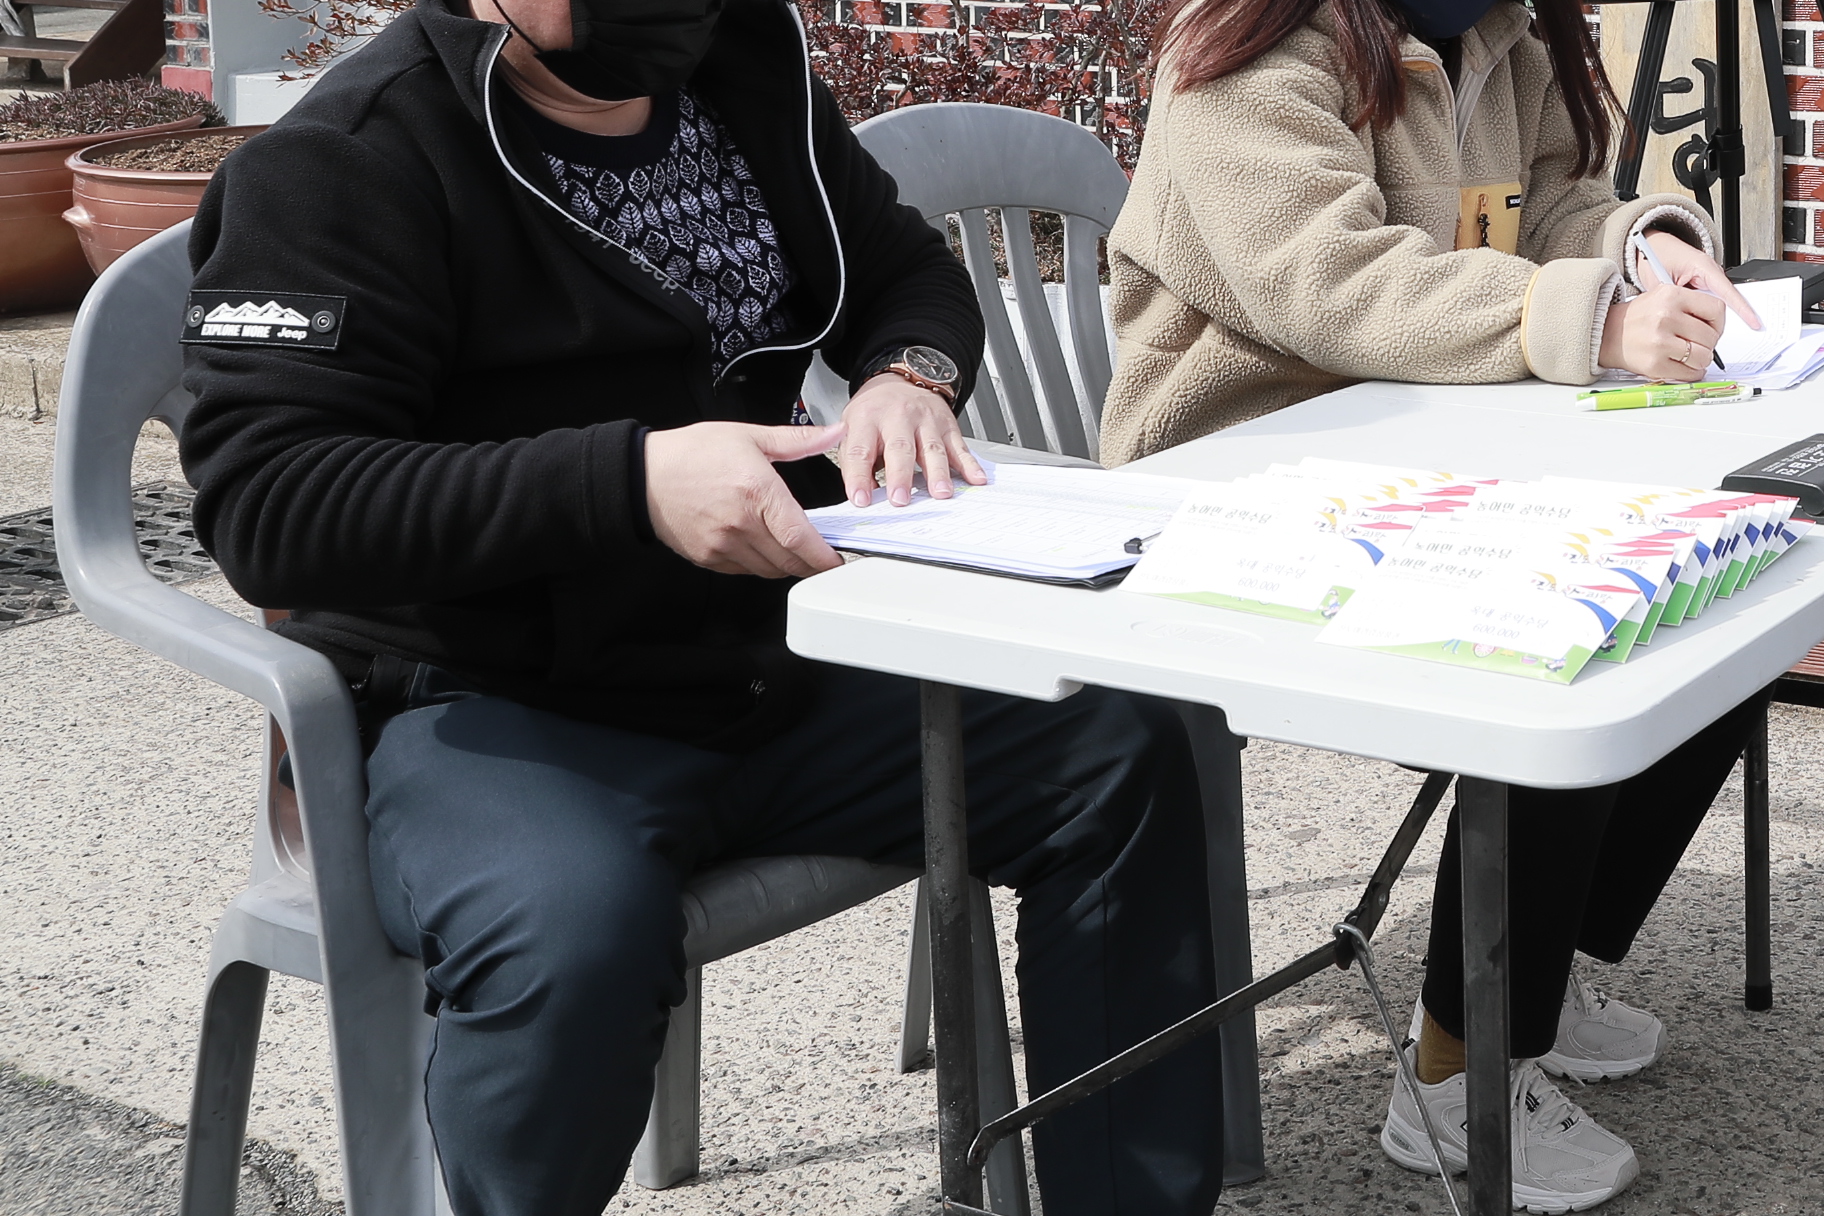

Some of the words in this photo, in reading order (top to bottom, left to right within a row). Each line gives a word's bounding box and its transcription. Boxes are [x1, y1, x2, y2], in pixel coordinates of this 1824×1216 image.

[201, 323, 242, 337] EXPLORE
[241, 325, 272, 339] MORE
[277, 326, 308, 341] Jeep
[1188, 503, 1223, 517] 농어민
[1225, 508, 1273, 524] 공익수당
[1476, 500, 1515, 512] 농어민
[1520, 503, 1571, 519] 공익수당
[1458, 545, 1513, 559] 공익수당
[1388, 557, 1427, 571] 농어민
[1430, 563, 1483, 579] 공익수당
